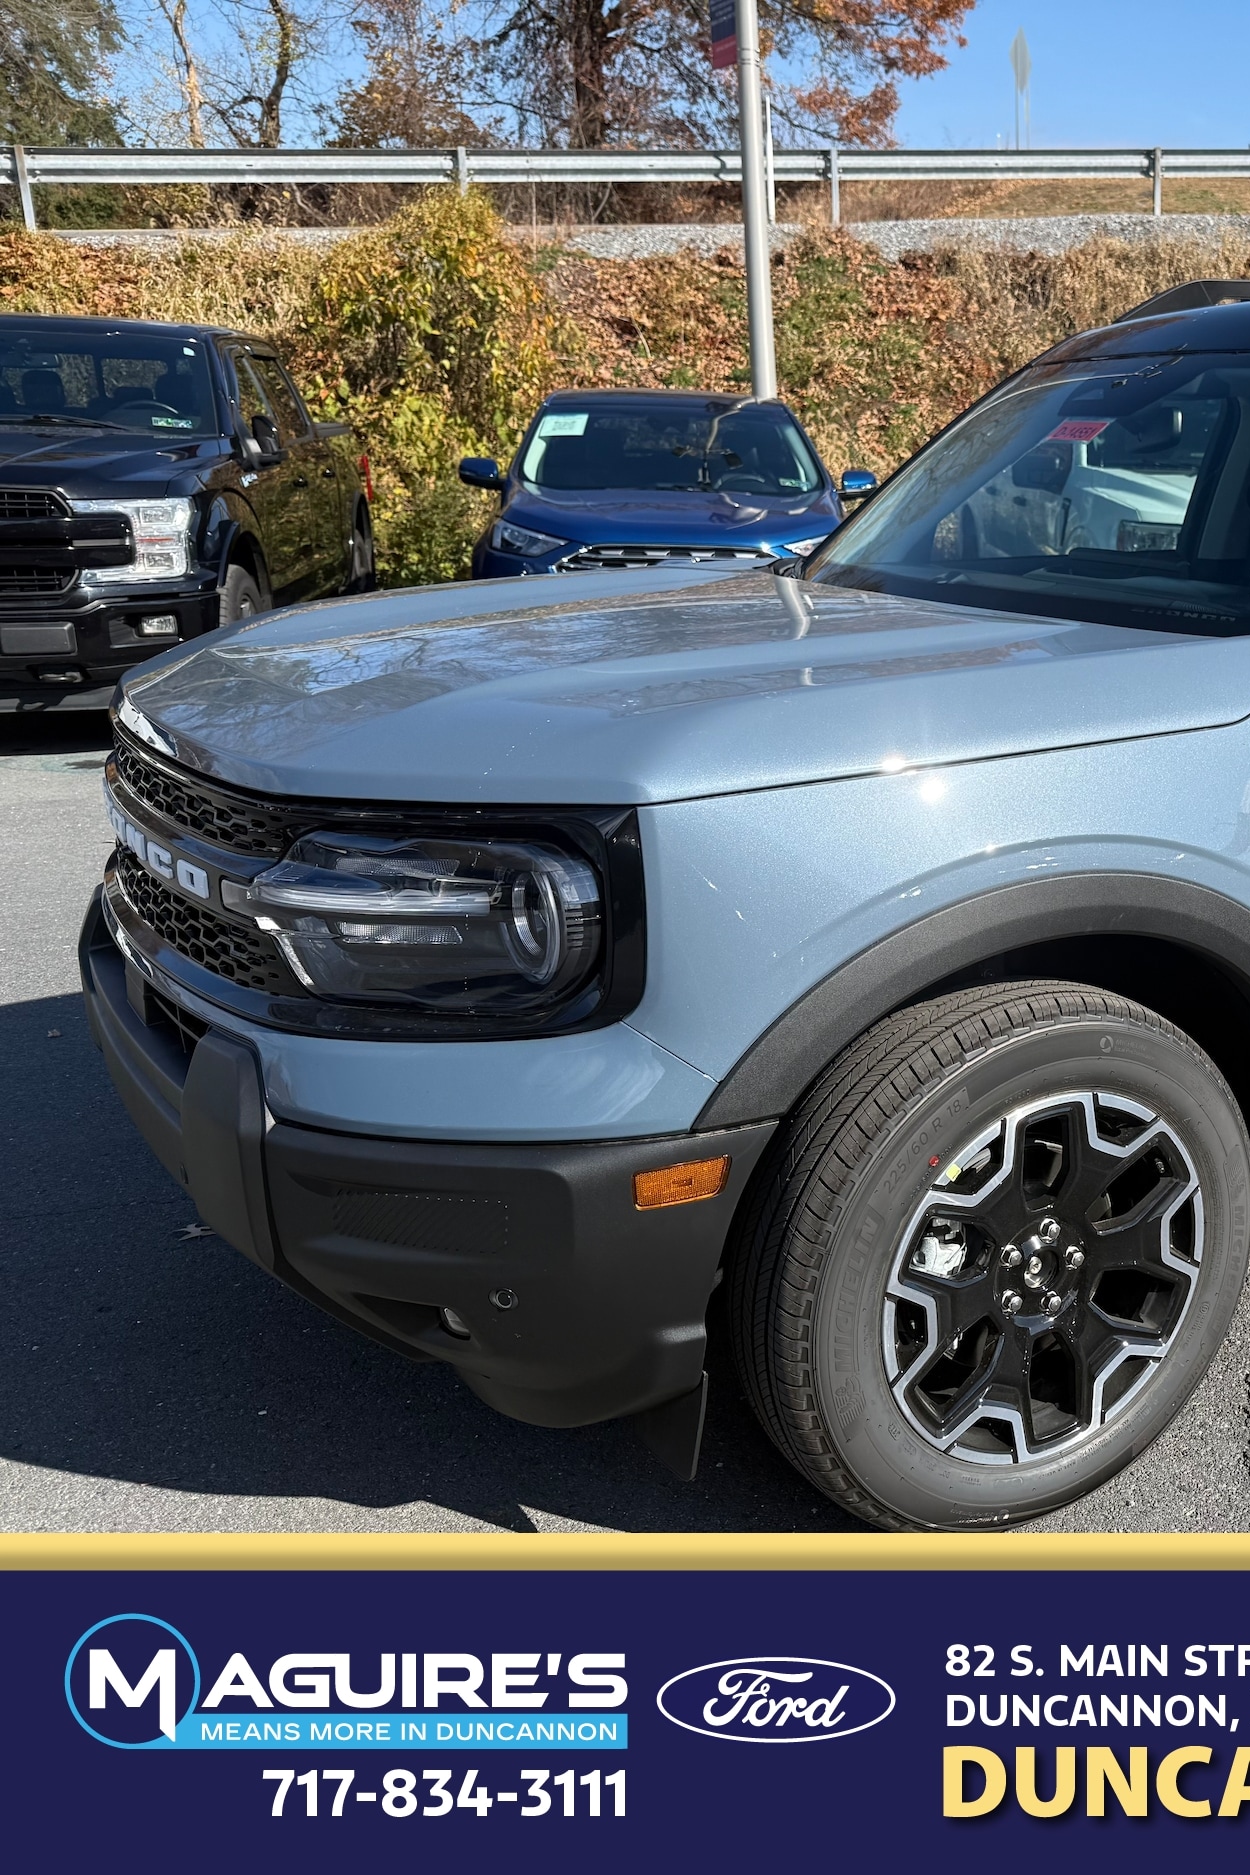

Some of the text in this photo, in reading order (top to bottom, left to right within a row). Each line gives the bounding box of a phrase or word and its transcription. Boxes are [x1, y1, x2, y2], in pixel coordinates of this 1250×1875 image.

[883, 1099, 962, 1194] 225/60 R 18
[835, 1215, 880, 1374] MICHELIN
[1211, 1204, 1246, 1336] MICHE
